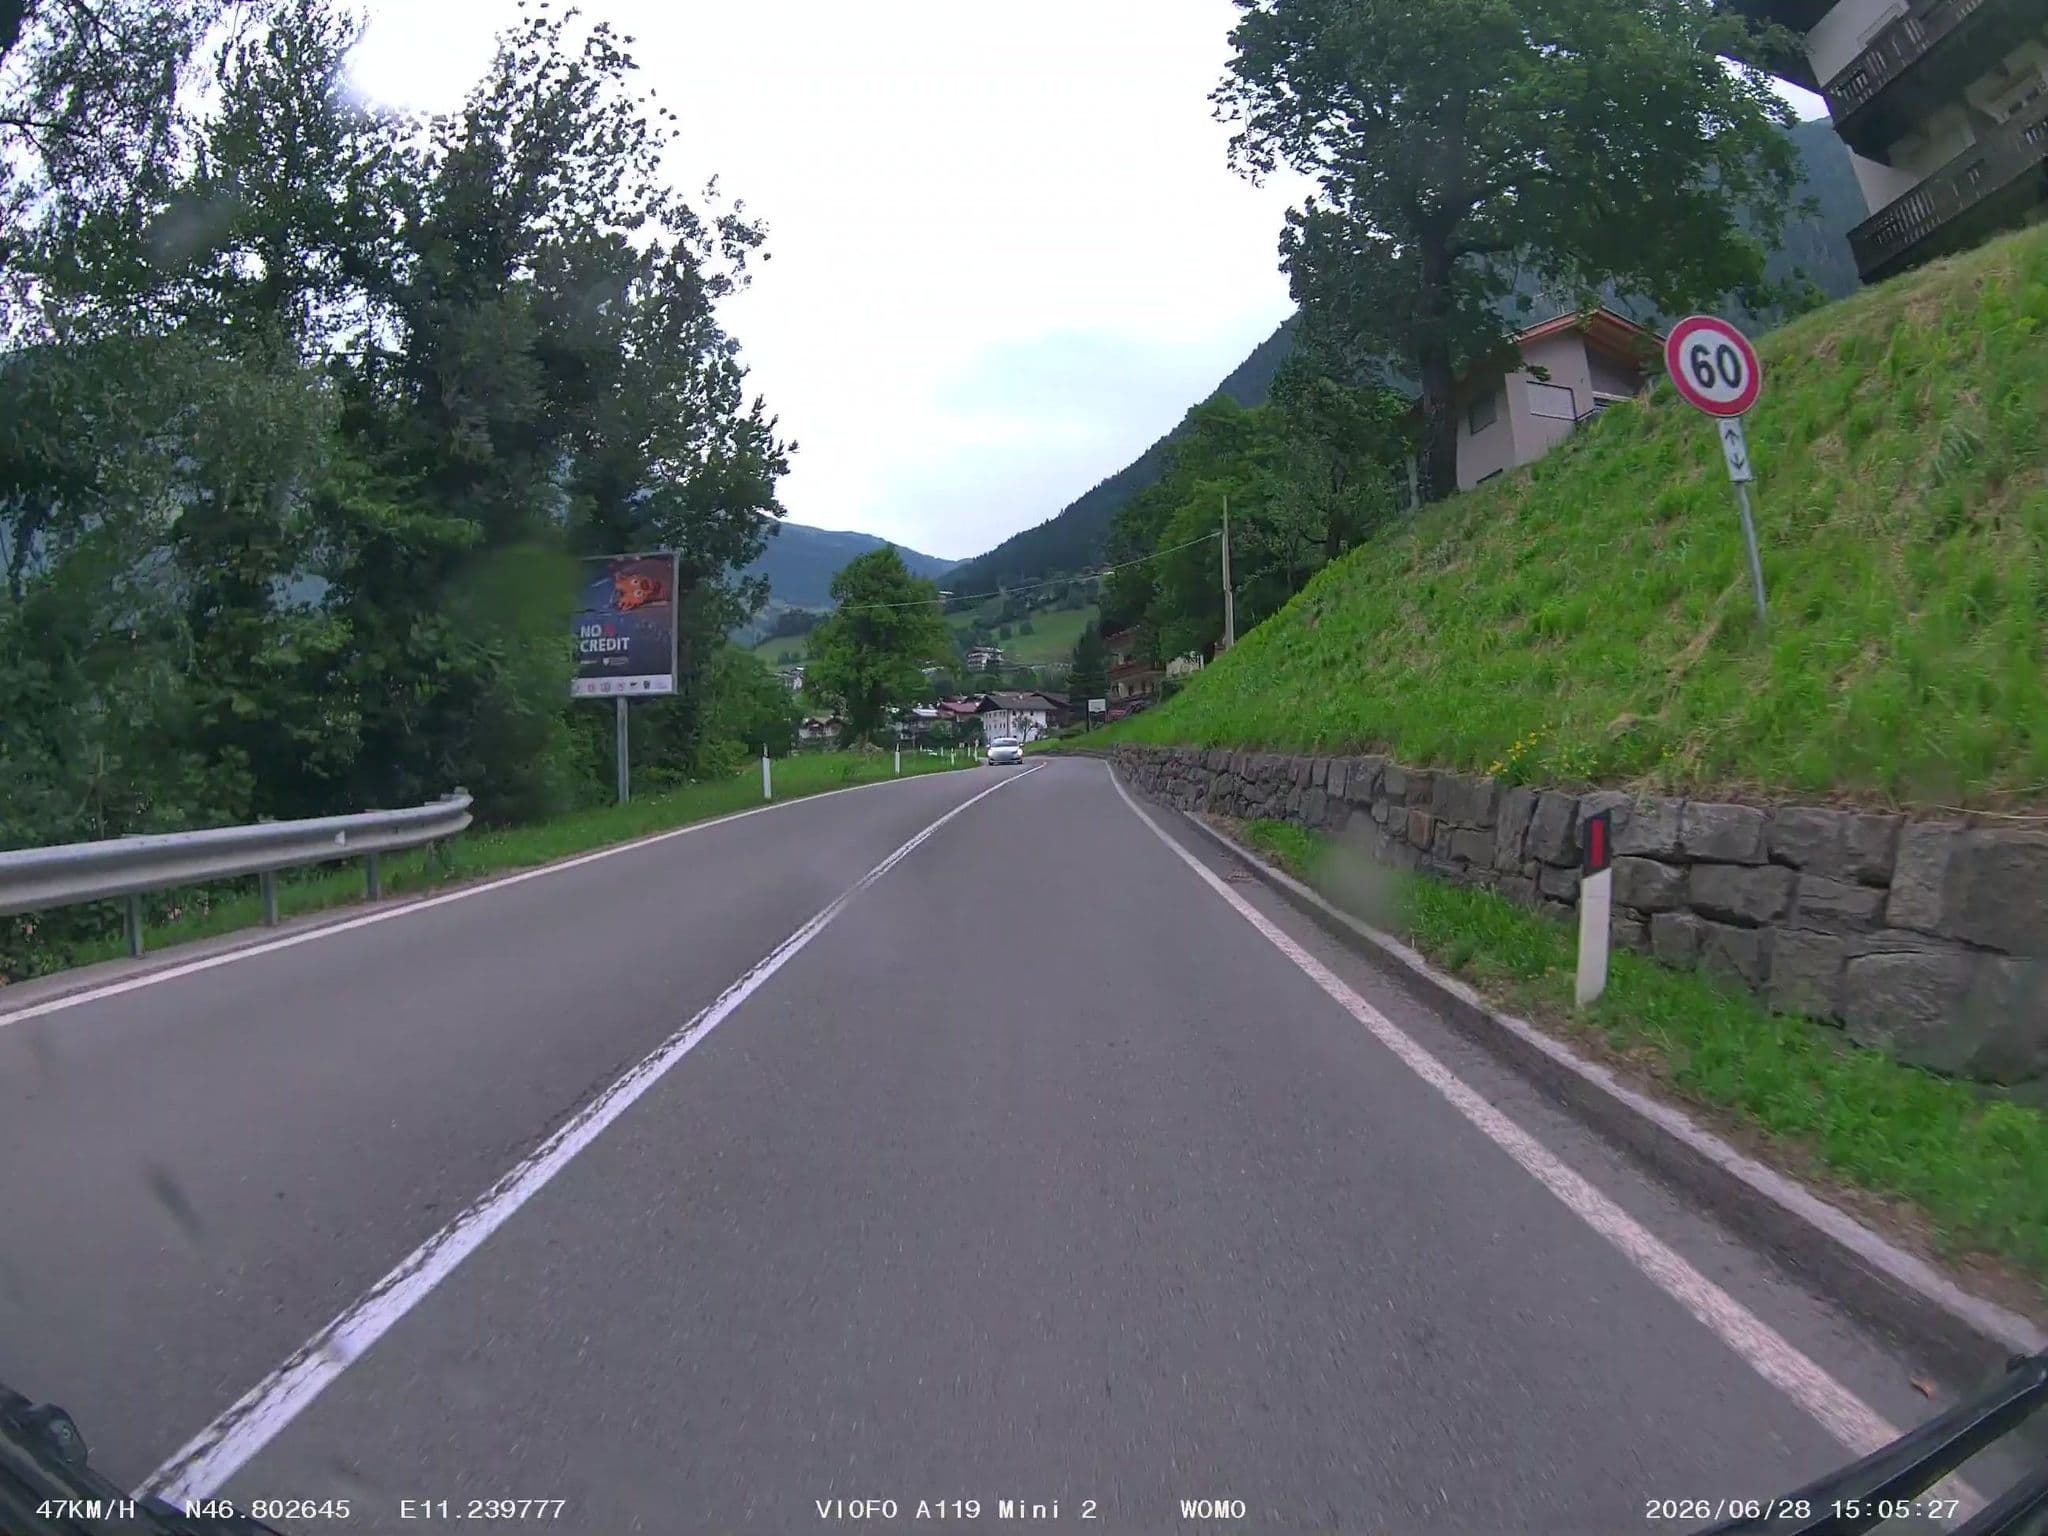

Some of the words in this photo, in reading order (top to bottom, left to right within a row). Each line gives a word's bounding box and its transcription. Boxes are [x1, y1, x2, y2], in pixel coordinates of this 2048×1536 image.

[1690, 344, 1741, 389] 60
[580, 624, 602, 638] NO
[580, 637, 630, 652] CREDIT
